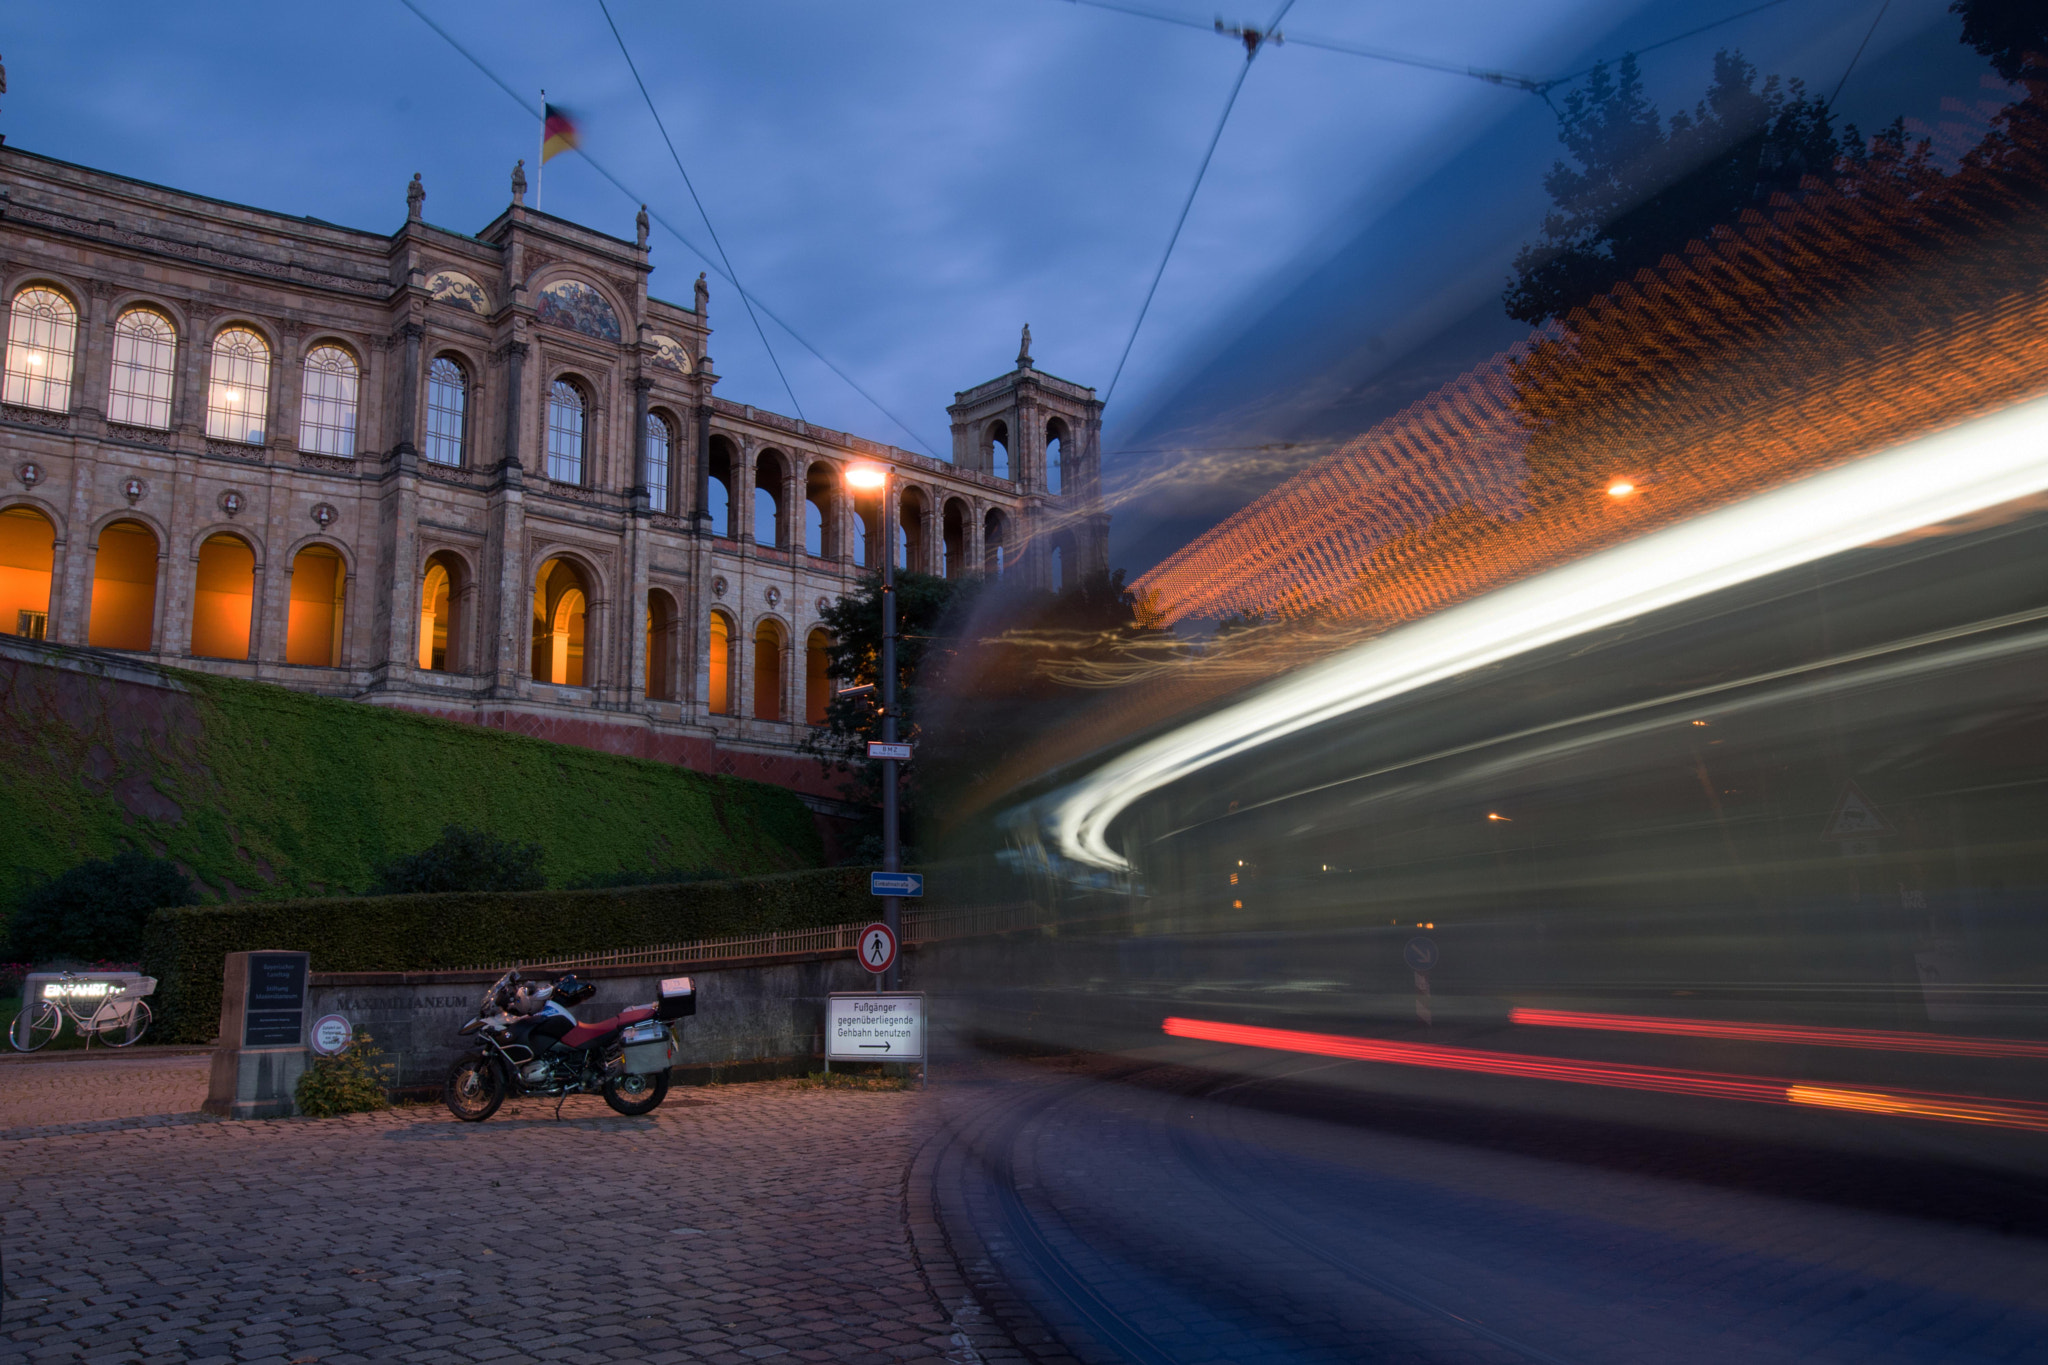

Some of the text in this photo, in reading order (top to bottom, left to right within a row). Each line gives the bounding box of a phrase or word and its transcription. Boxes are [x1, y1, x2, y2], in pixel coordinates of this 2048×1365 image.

[44, 983, 108, 998] EINFAHRT
[336, 996, 468, 1011] MAXIMILIANEUM
[854, 1002, 897, 1014] Fußgänger
[838, 1015, 914, 1027] gegenüberliegende
[838, 1027, 911, 1038] Gehbahn benutzen
